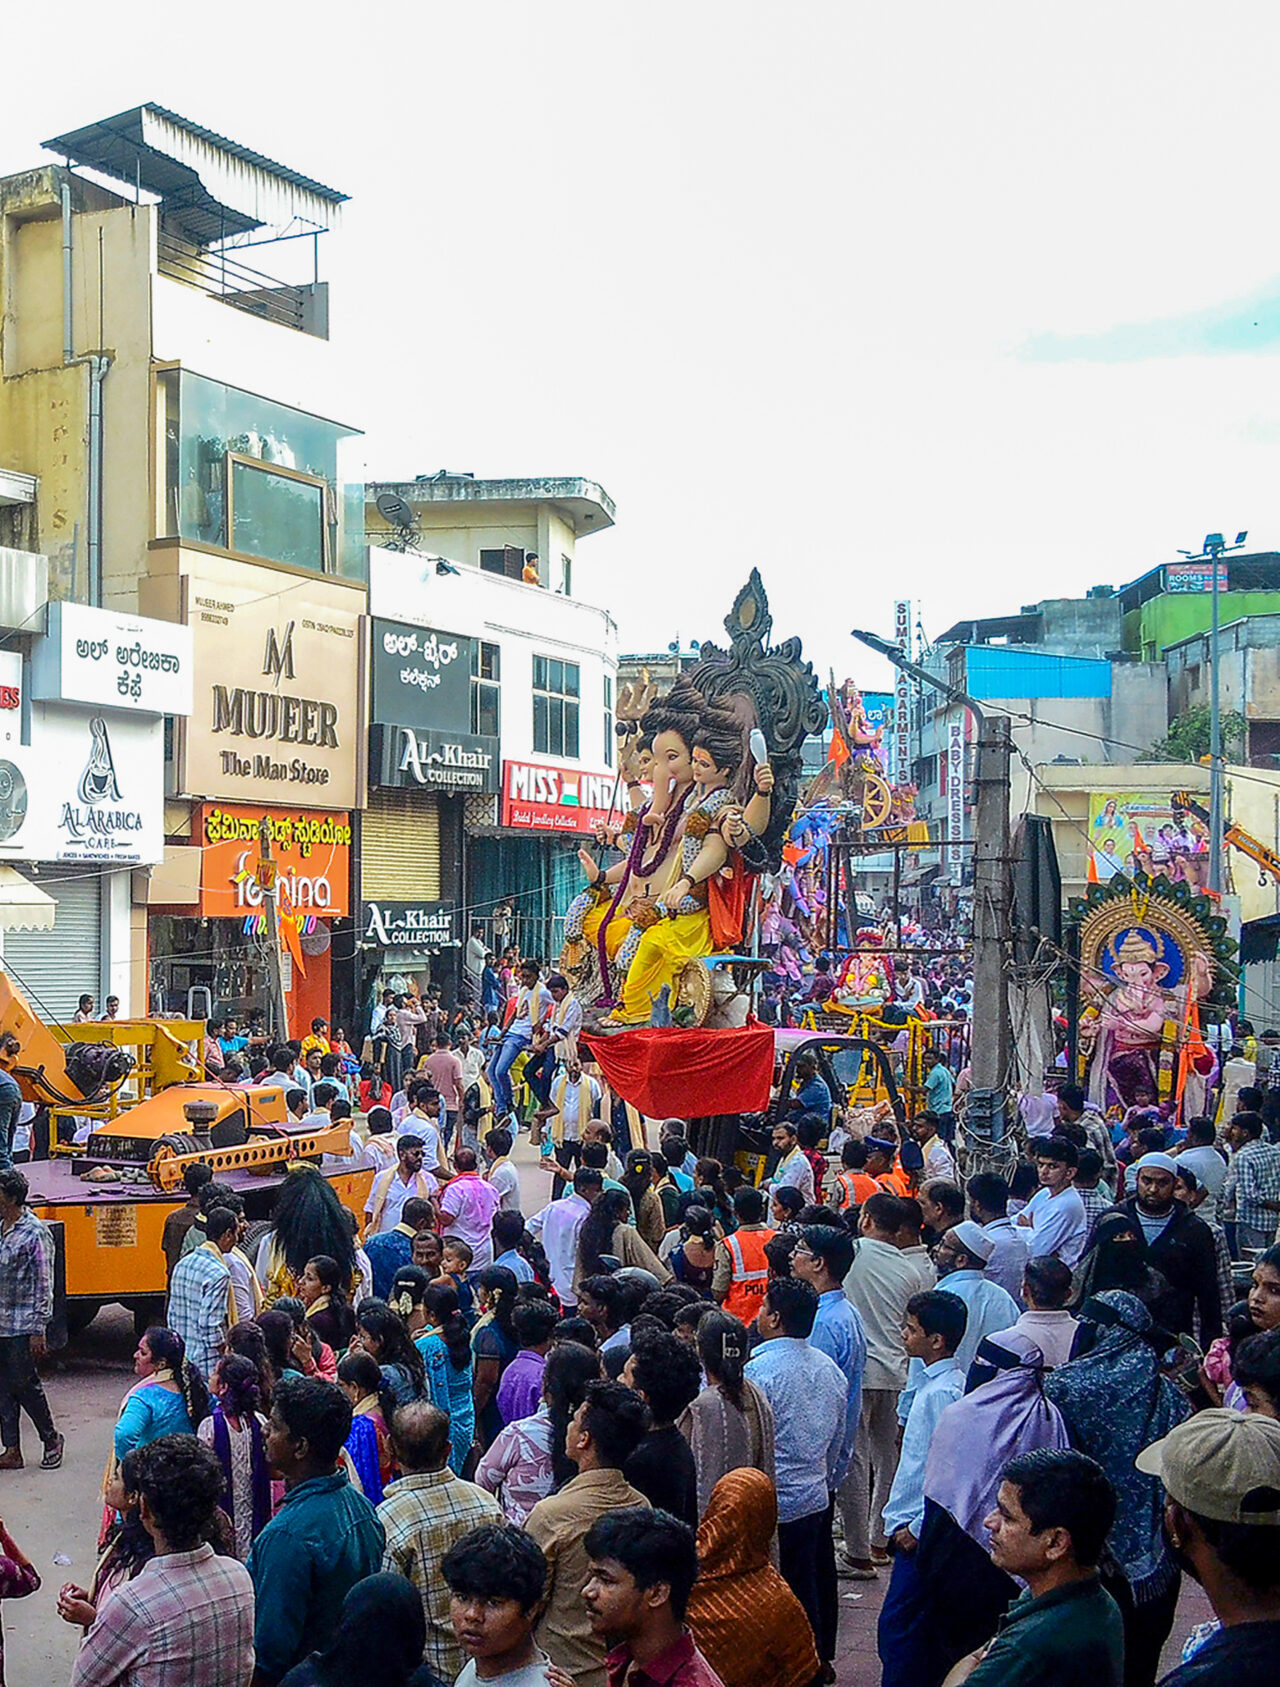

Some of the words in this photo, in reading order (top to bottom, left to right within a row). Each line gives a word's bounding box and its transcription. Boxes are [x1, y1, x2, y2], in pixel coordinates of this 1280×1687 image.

[76, 639, 109, 660] ಅಲ್
[211, 685, 339, 749] MUJEER
[950, 726, 962, 772] BABY
[220, 750, 252, 778] The
[253, 754, 288, 782] Man
[288, 758, 329, 786] Store
[427, 768, 483, 786] COLLECTION
[509, 764, 559, 804] MISS
[242, 915, 269, 935] KID
[391, 930, 450, 944] COLLECTION
